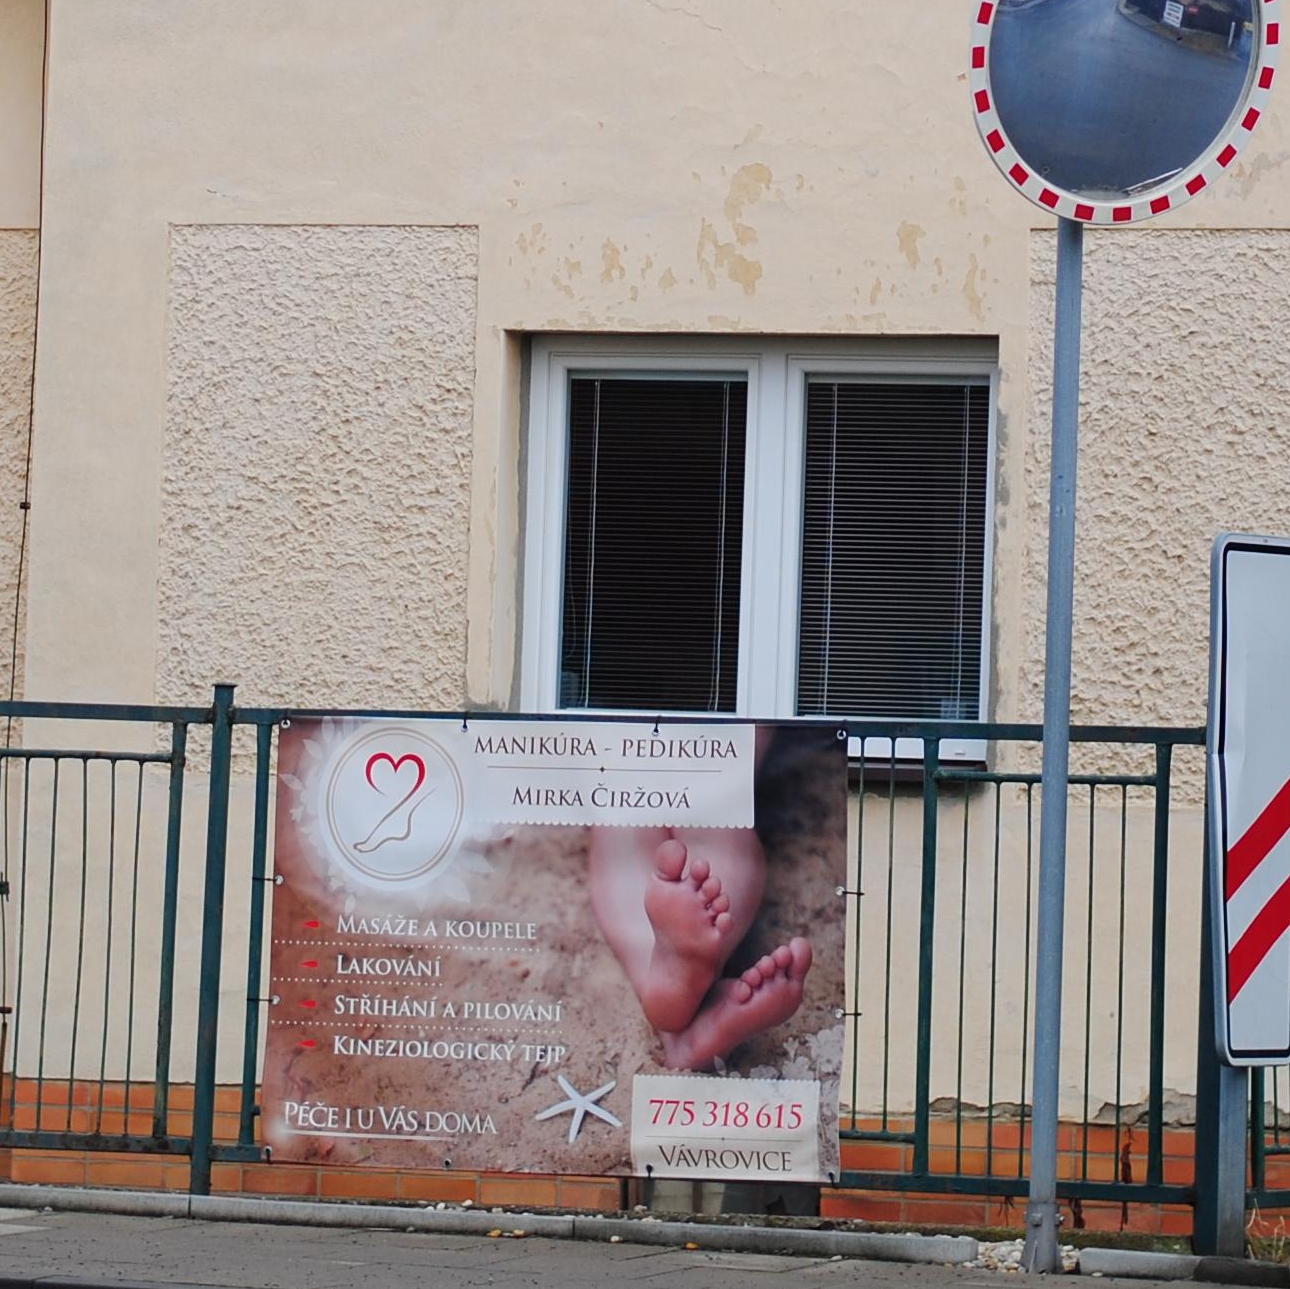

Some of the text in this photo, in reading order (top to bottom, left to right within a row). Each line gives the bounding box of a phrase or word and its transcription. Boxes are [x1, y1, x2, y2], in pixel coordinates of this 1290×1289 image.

[474, 732, 597, 756] MANIKÚRA
[621, 735, 738, 758] PEDIKÚRA
[649, 1099, 803, 1130] 775 318 615
